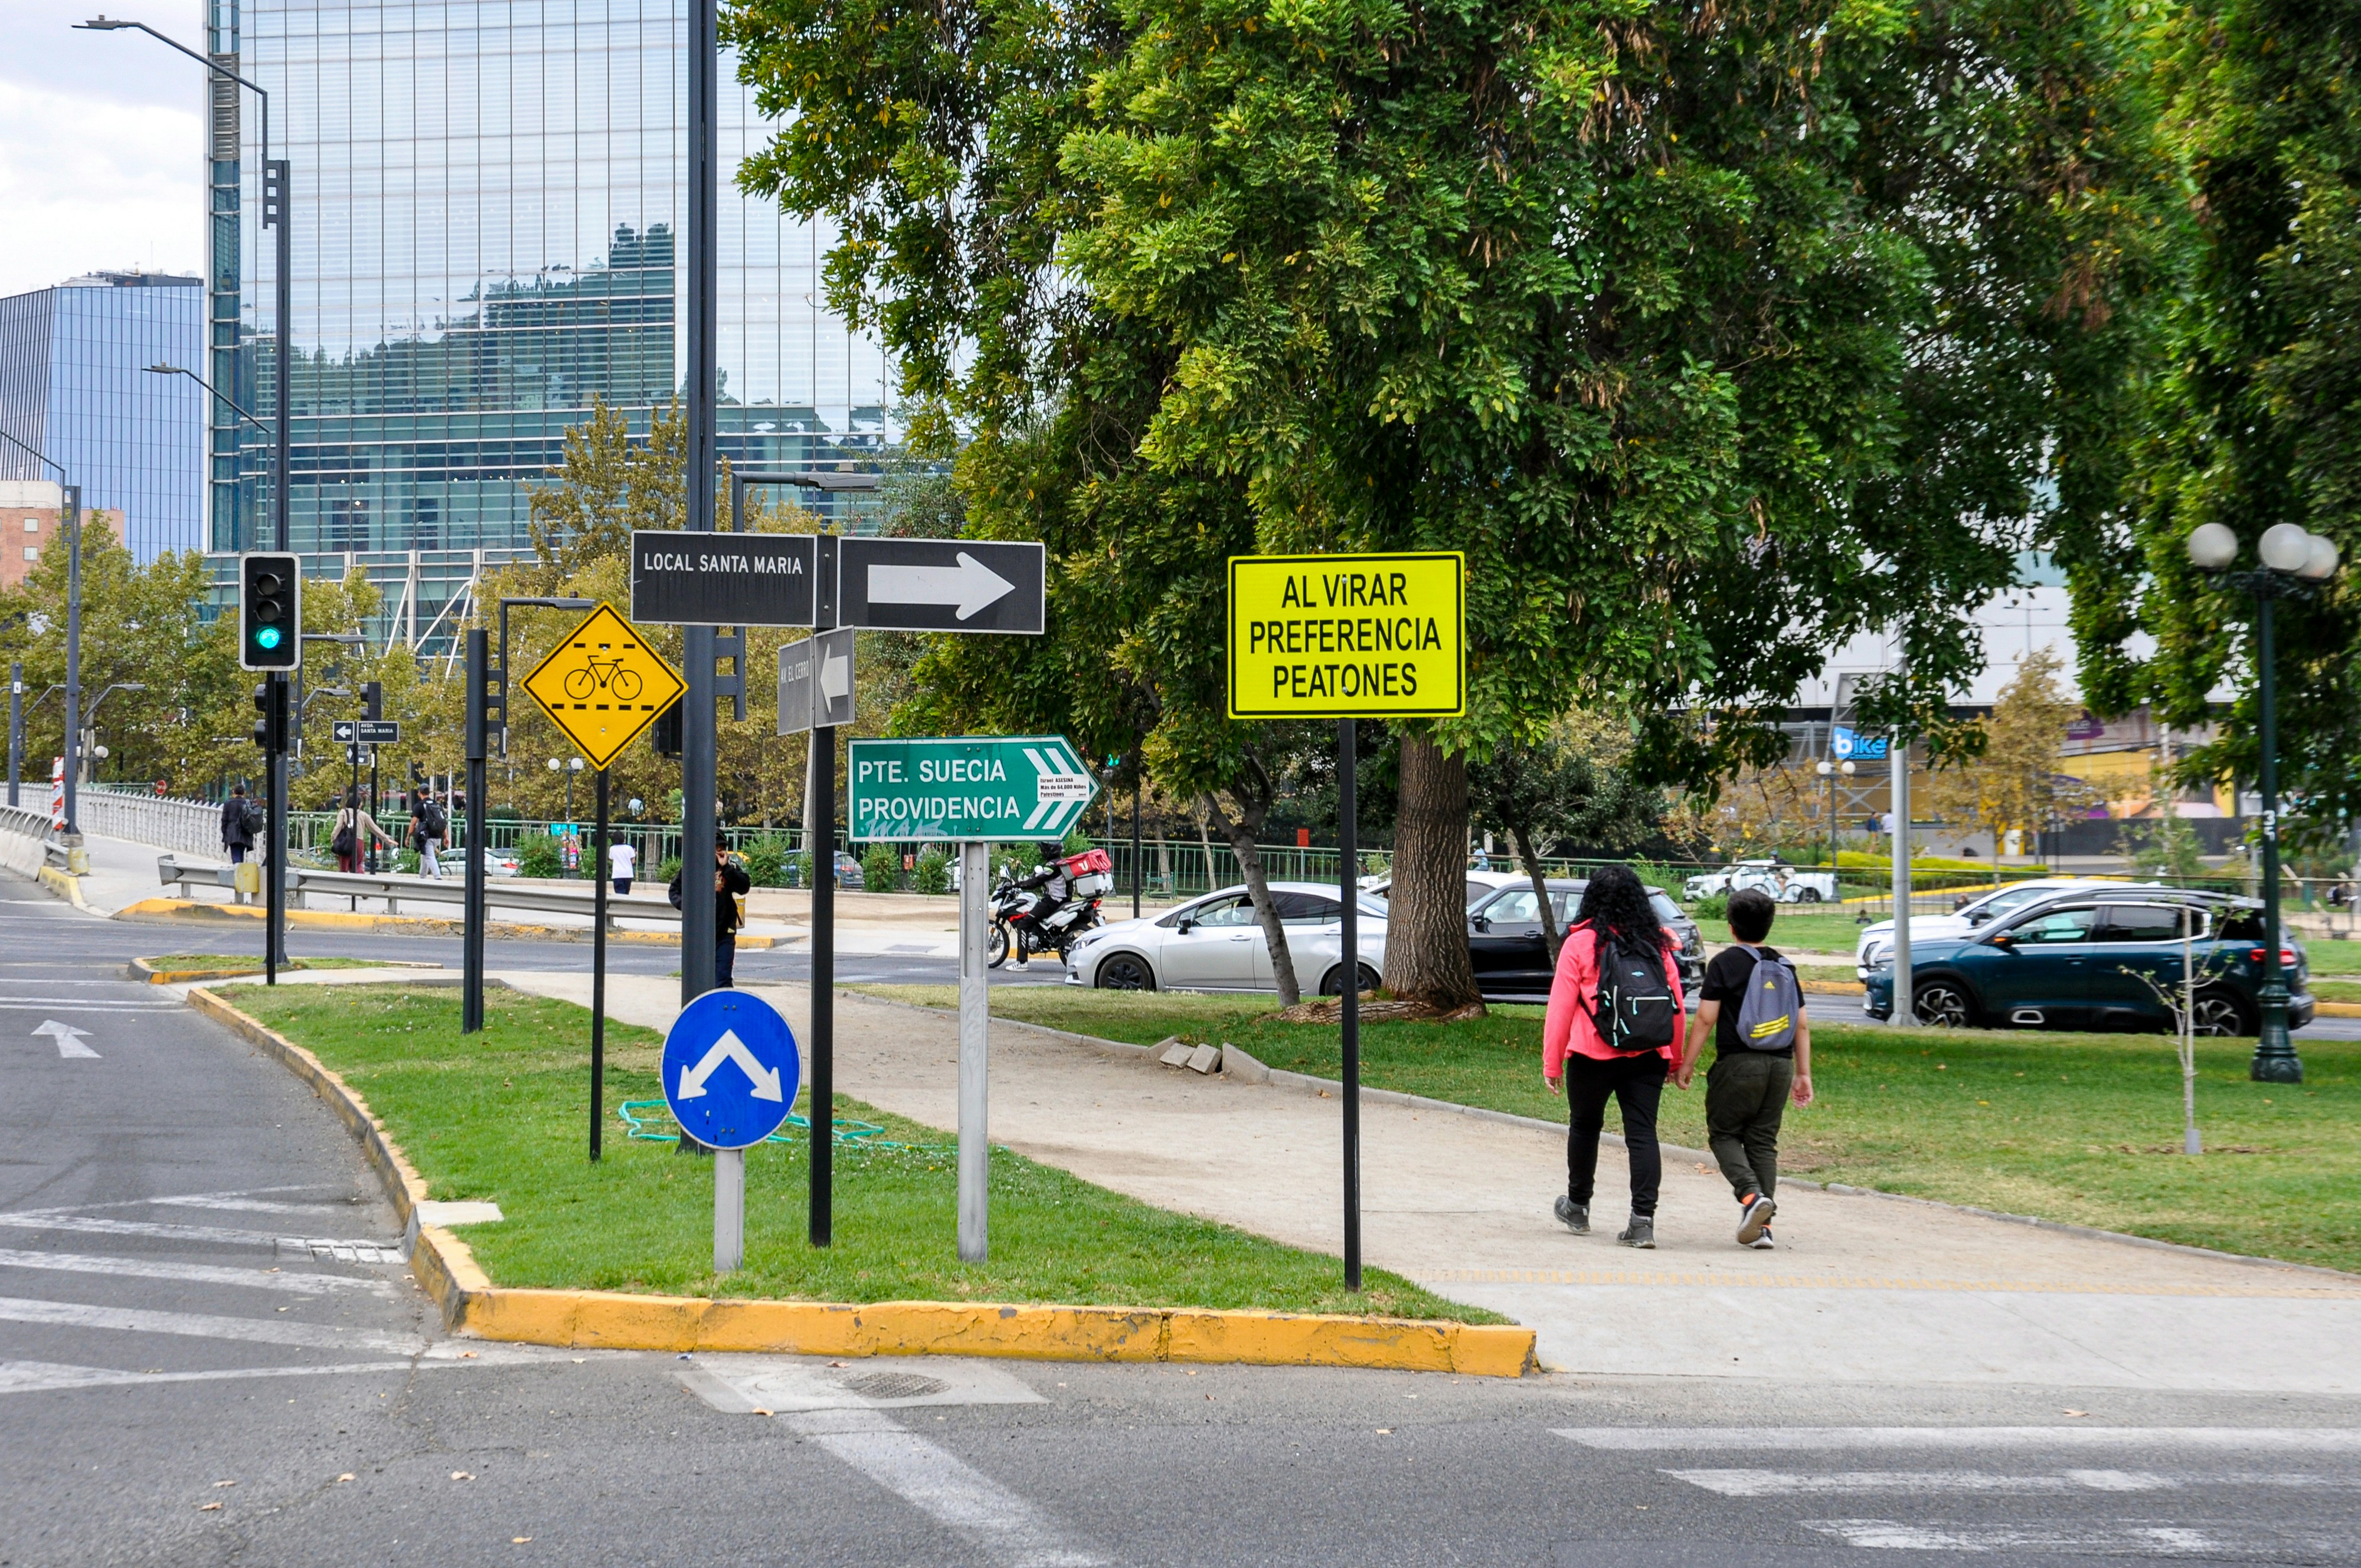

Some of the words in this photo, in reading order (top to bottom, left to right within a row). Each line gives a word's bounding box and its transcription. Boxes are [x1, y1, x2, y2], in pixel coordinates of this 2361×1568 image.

[644, 552, 694, 572] LOCAL
[699, 554, 749, 574] SANTA
[753, 555, 803, 575] MARIA
[1281, 575, 1317, 608] AL
[1322, 572, 1408, 607] VIRAR
[1250, 617, 1442, 654] PREFERENCIA
[789, 665, 794, 682] EL
[1273, 662, 1417, 699] PEATONES
[859, 760, 909, 783] PTE.
[919, 759, 1006, 783] SUECIA
[859, 796, 1021, 820] PROVIDENCIA
